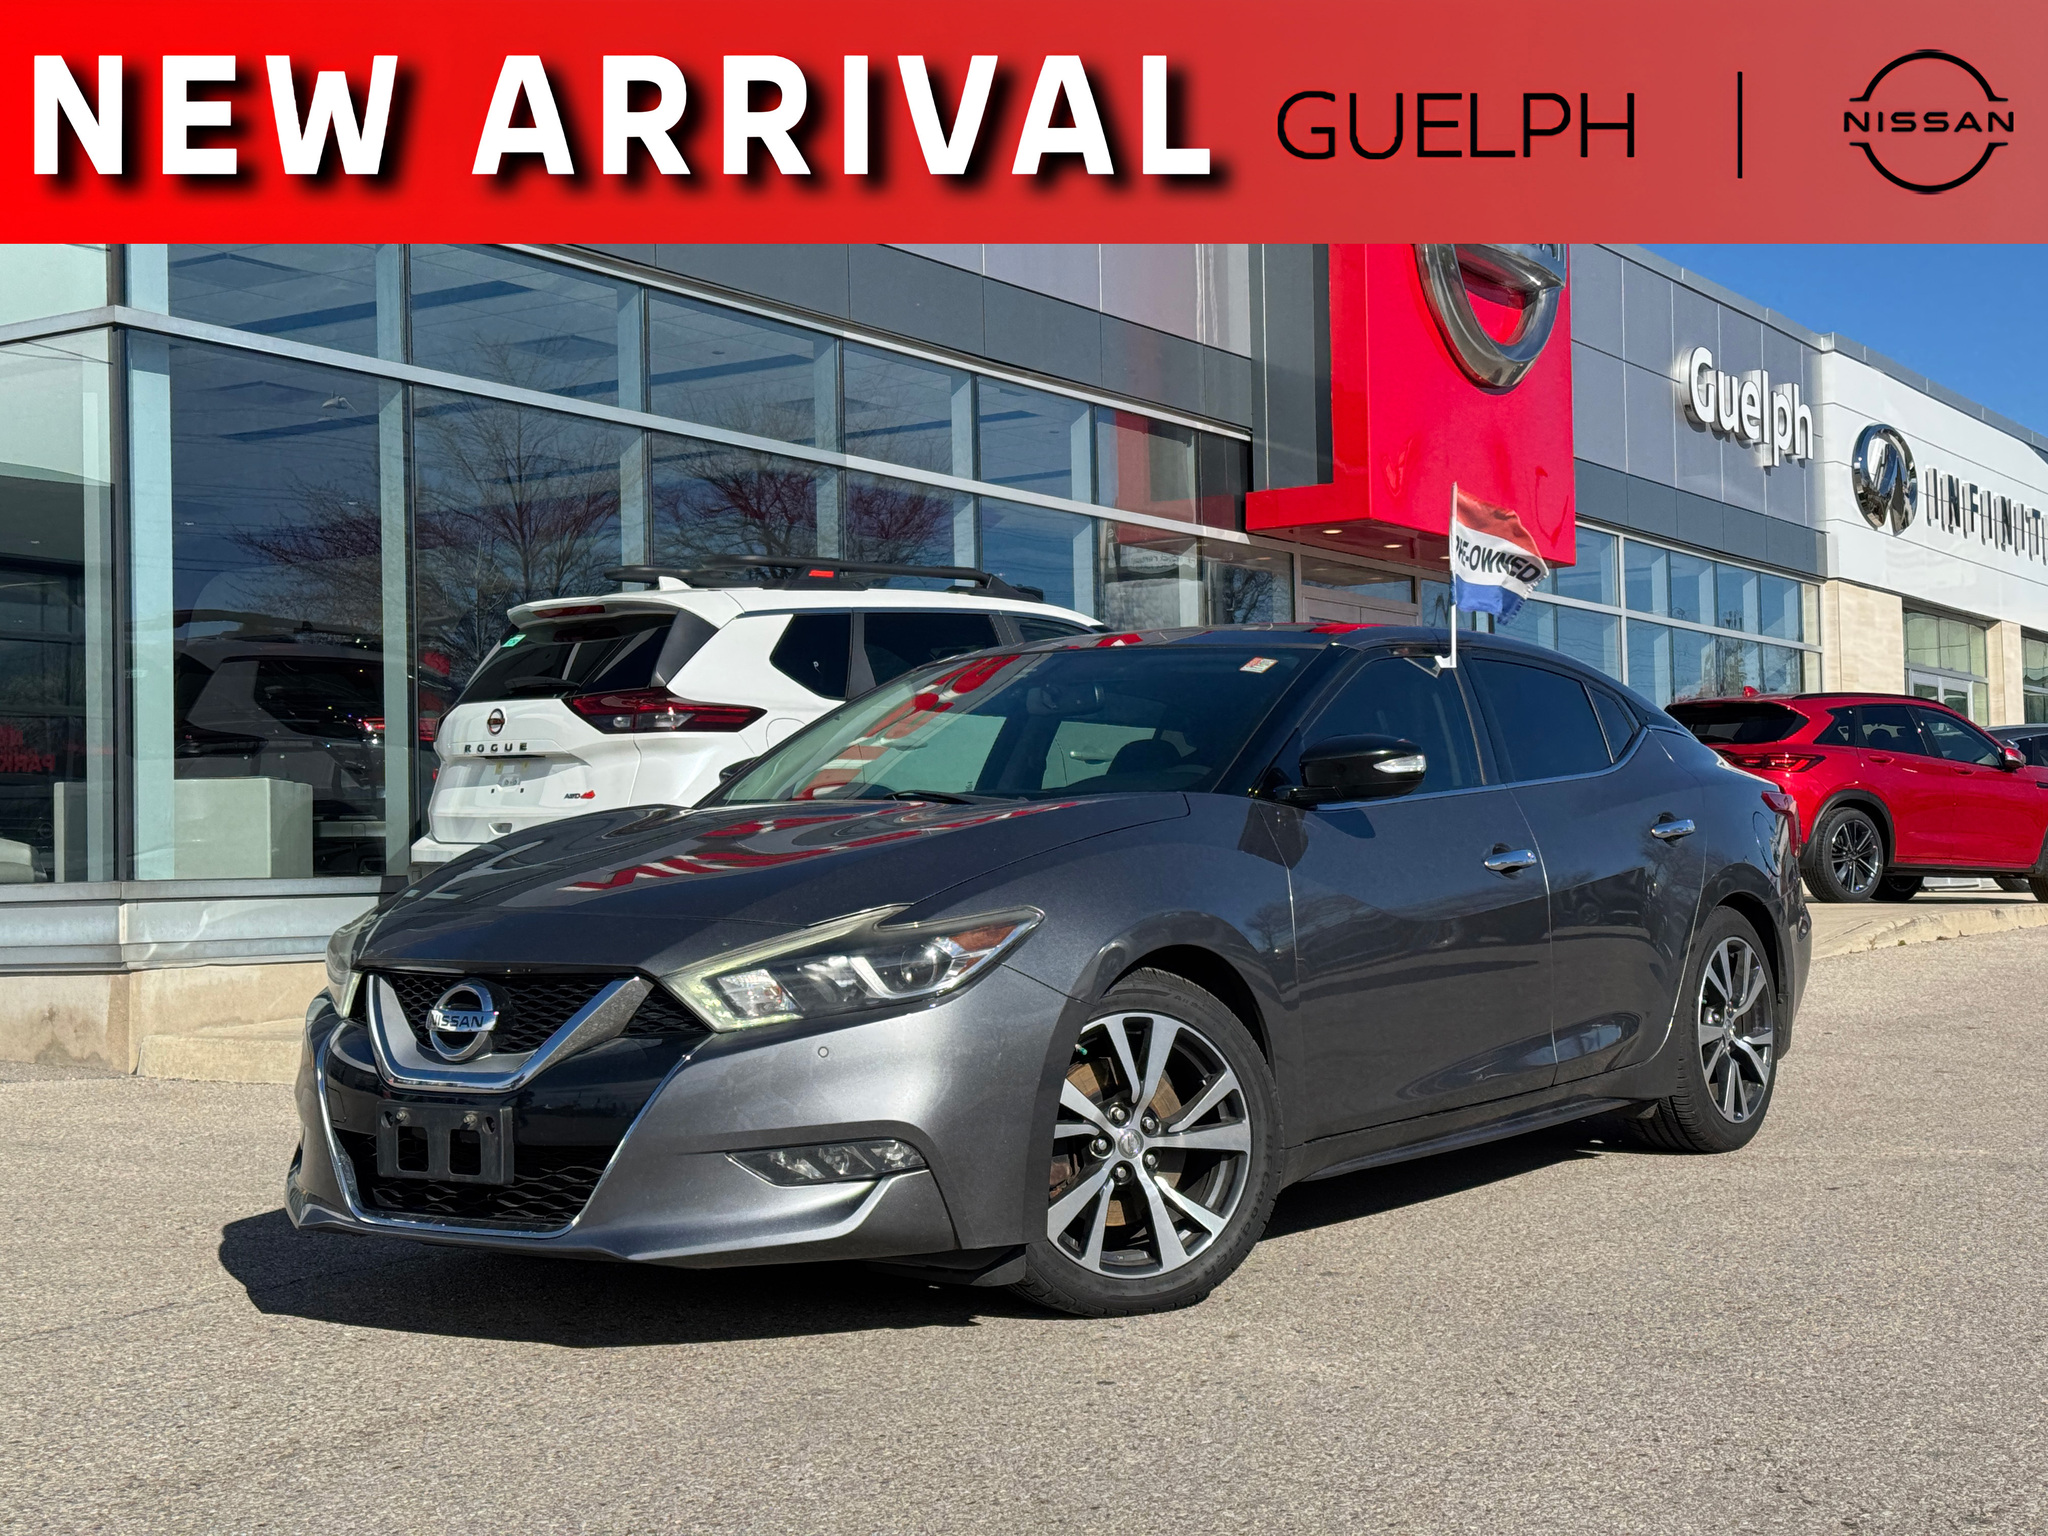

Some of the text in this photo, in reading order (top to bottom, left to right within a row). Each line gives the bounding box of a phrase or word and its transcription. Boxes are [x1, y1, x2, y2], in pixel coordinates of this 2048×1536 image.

[1686, 346, 1814, 468] Guelph
[464, 742, 528, 754] ROGUE
[431, 1014, 484, 1028] NISSAN
